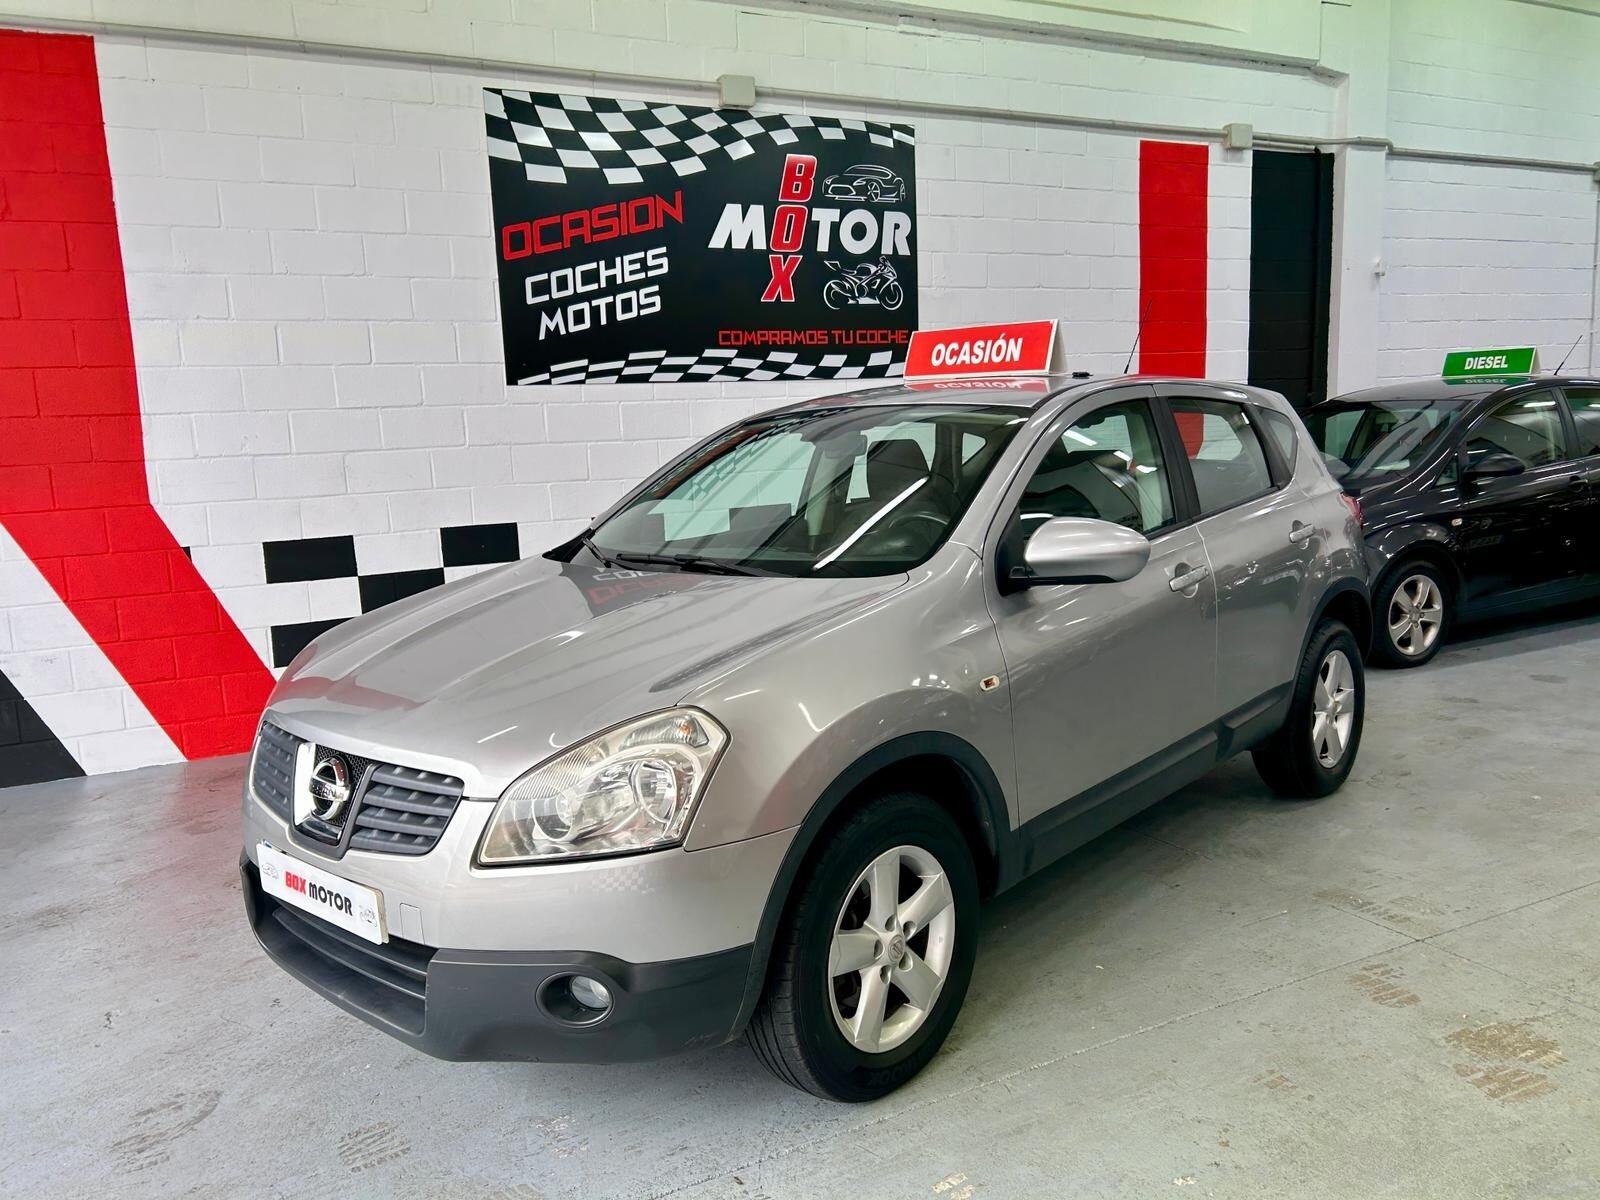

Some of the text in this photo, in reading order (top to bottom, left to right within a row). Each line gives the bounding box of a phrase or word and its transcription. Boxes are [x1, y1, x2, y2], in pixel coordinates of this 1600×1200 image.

[502, 189, 684, 261] OCASION
[707, 203, 912, 256] MOTOR
[761, 153, 817, 302] BOX
[525, 246, 669, 305] COCHES
[538, 285, 661, 341] MOTOS
[718, 330, 909, 346] COMPRAMOS TU COCHE
[931, 333, 1023, 367] OCASIÓN
[1464, 355, 1508, 370] DIESEL
[285, 870, 353, 917] BOX MOTOR
